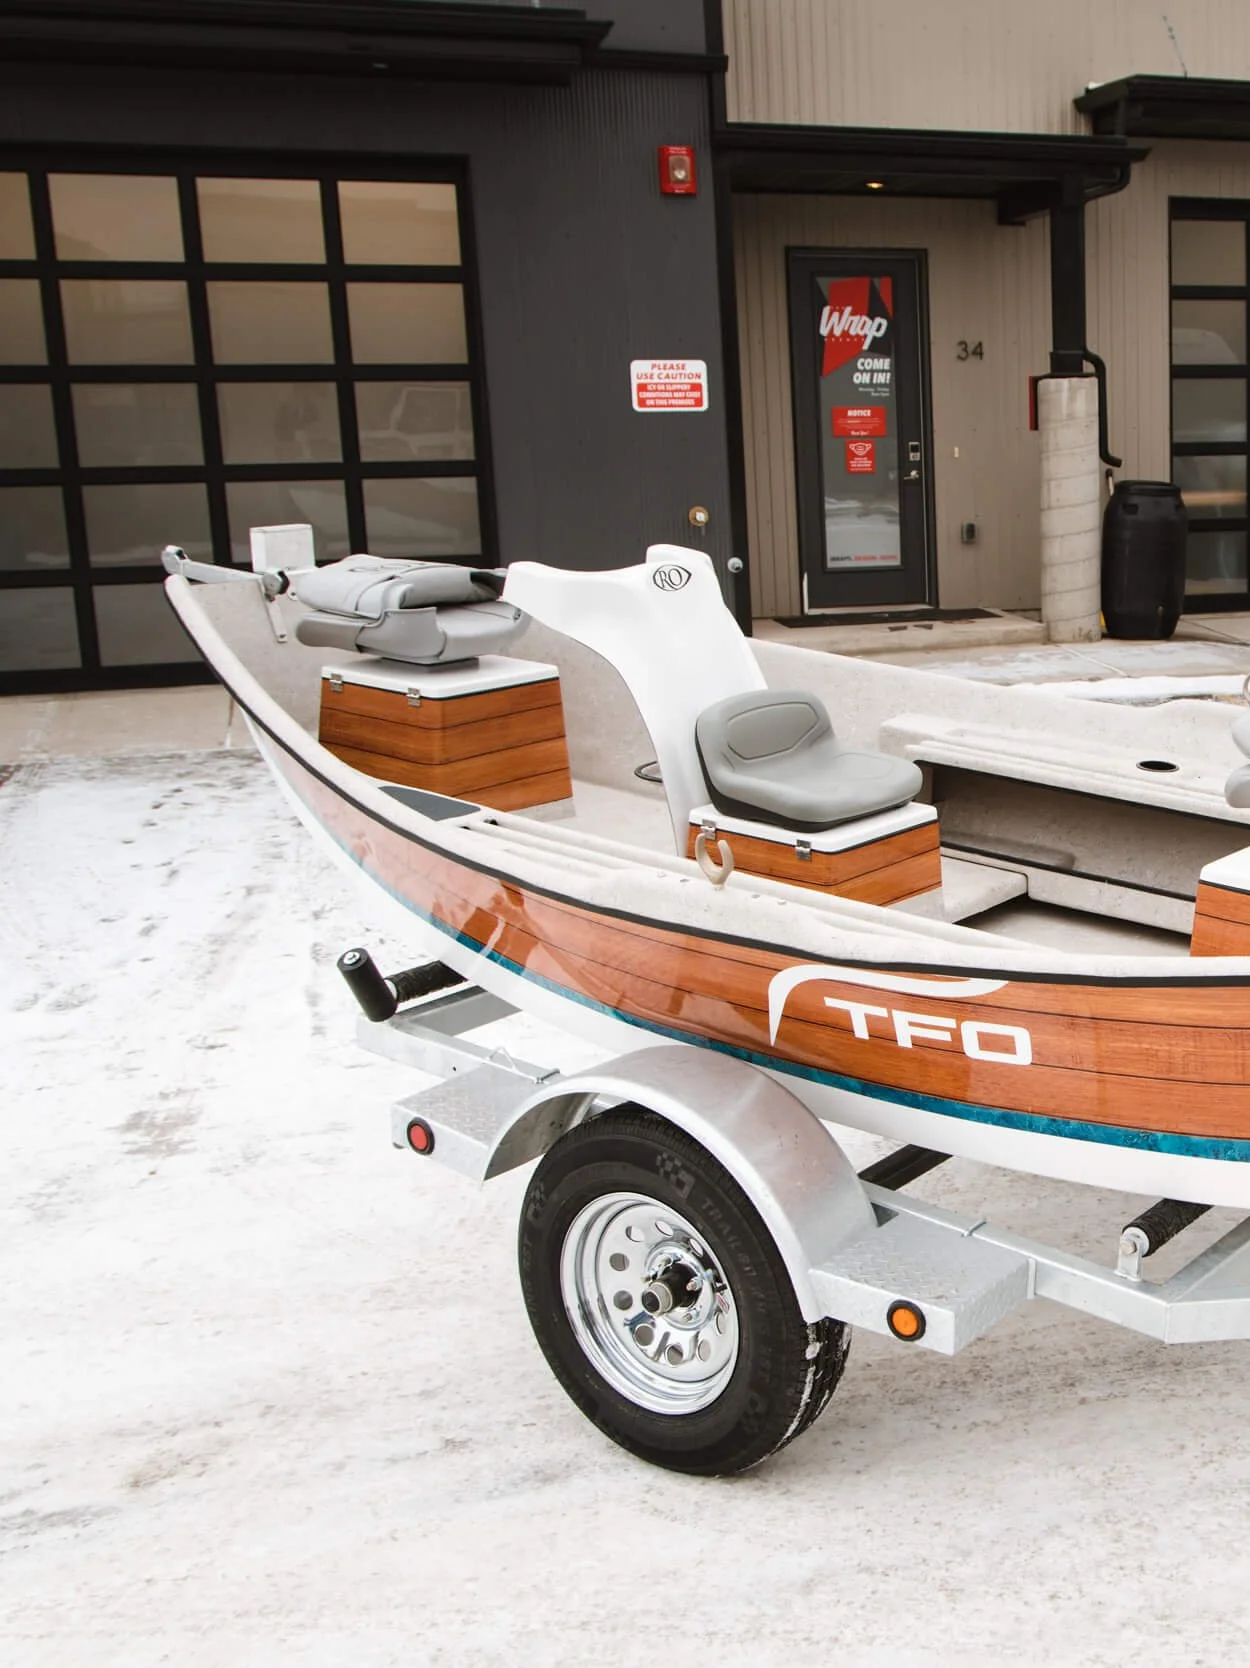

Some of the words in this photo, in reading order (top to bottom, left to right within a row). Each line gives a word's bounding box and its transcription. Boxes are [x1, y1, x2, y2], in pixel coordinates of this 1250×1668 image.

[819, 305, 888, 351] Wrap
[956, 340, 984, 361] 34
[651, 363, 686, 371] PLEASE
[857, 358, 891, 370] COME
[636, 372, 654, 380] USE
[657, 371, 702, 380] CAUTION
[853, 372, 870, 384] ON
[873, 372, 891, 384] IN!
[823, 996, 1033, 1066] TFO
